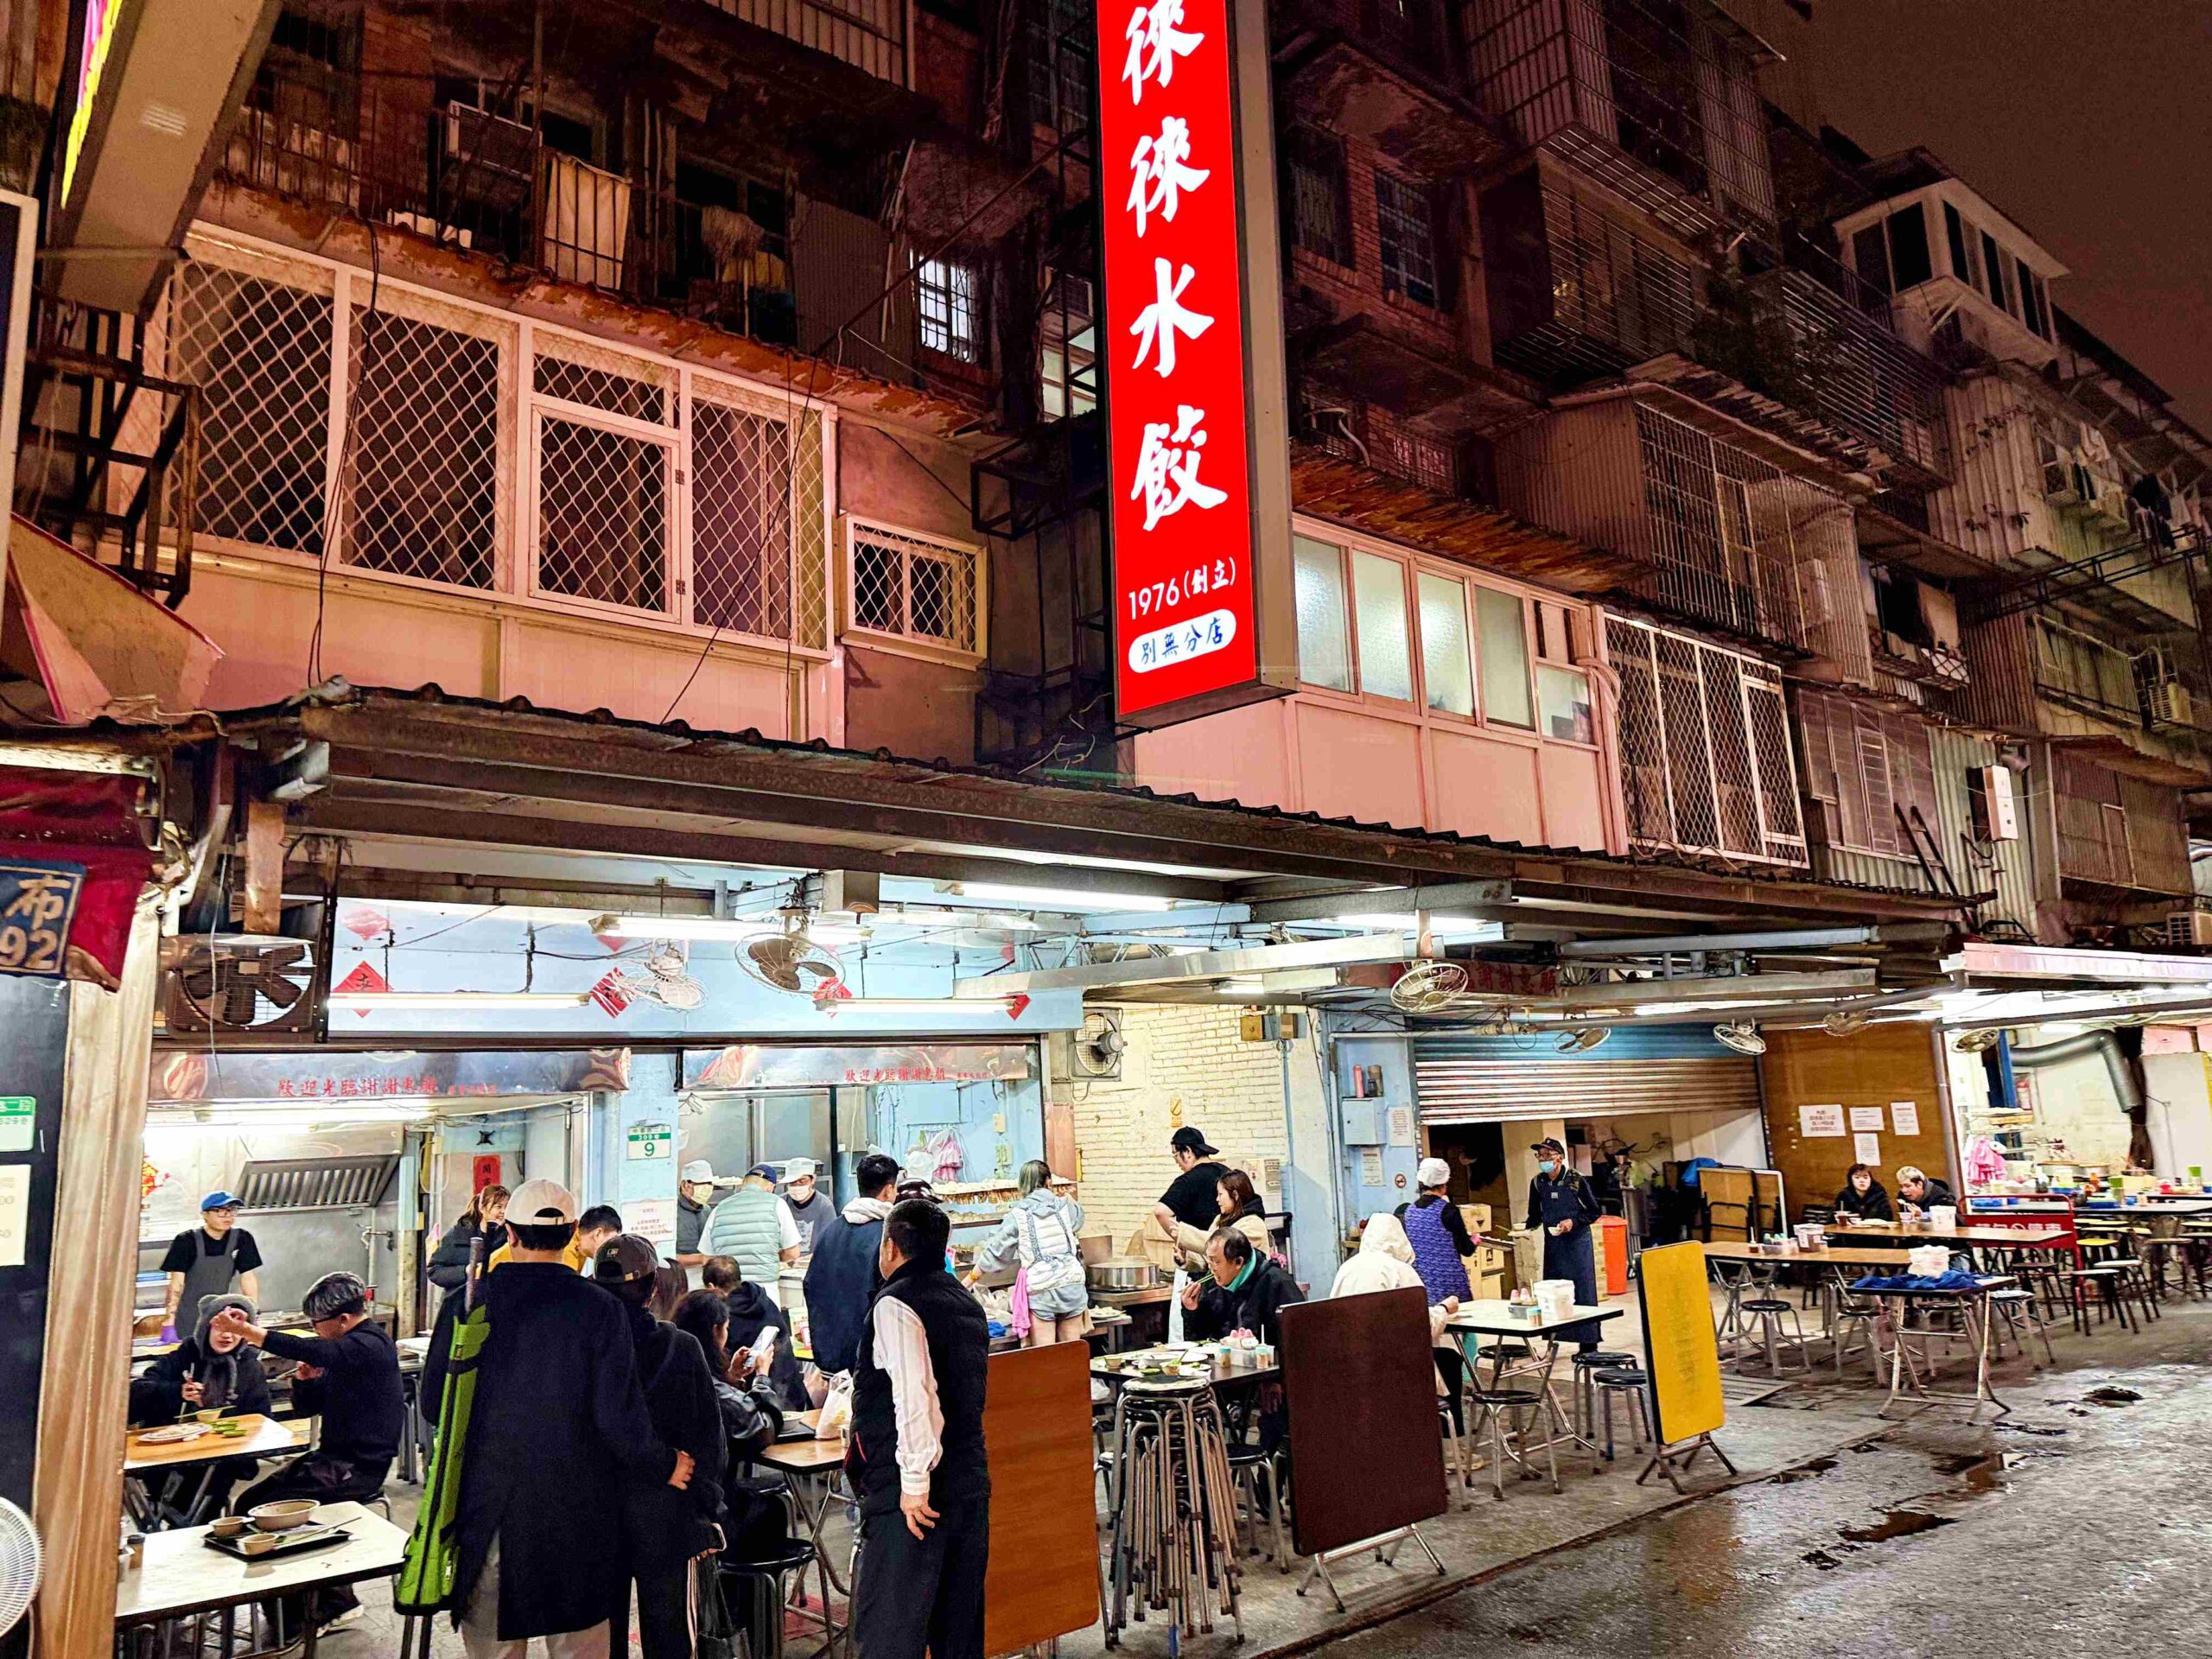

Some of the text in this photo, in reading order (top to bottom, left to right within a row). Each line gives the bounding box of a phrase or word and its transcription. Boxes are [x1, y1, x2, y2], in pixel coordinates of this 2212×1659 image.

[1141, 616, 1224, 664] 別無分店
[644, 1141, 655, 1157] 9
